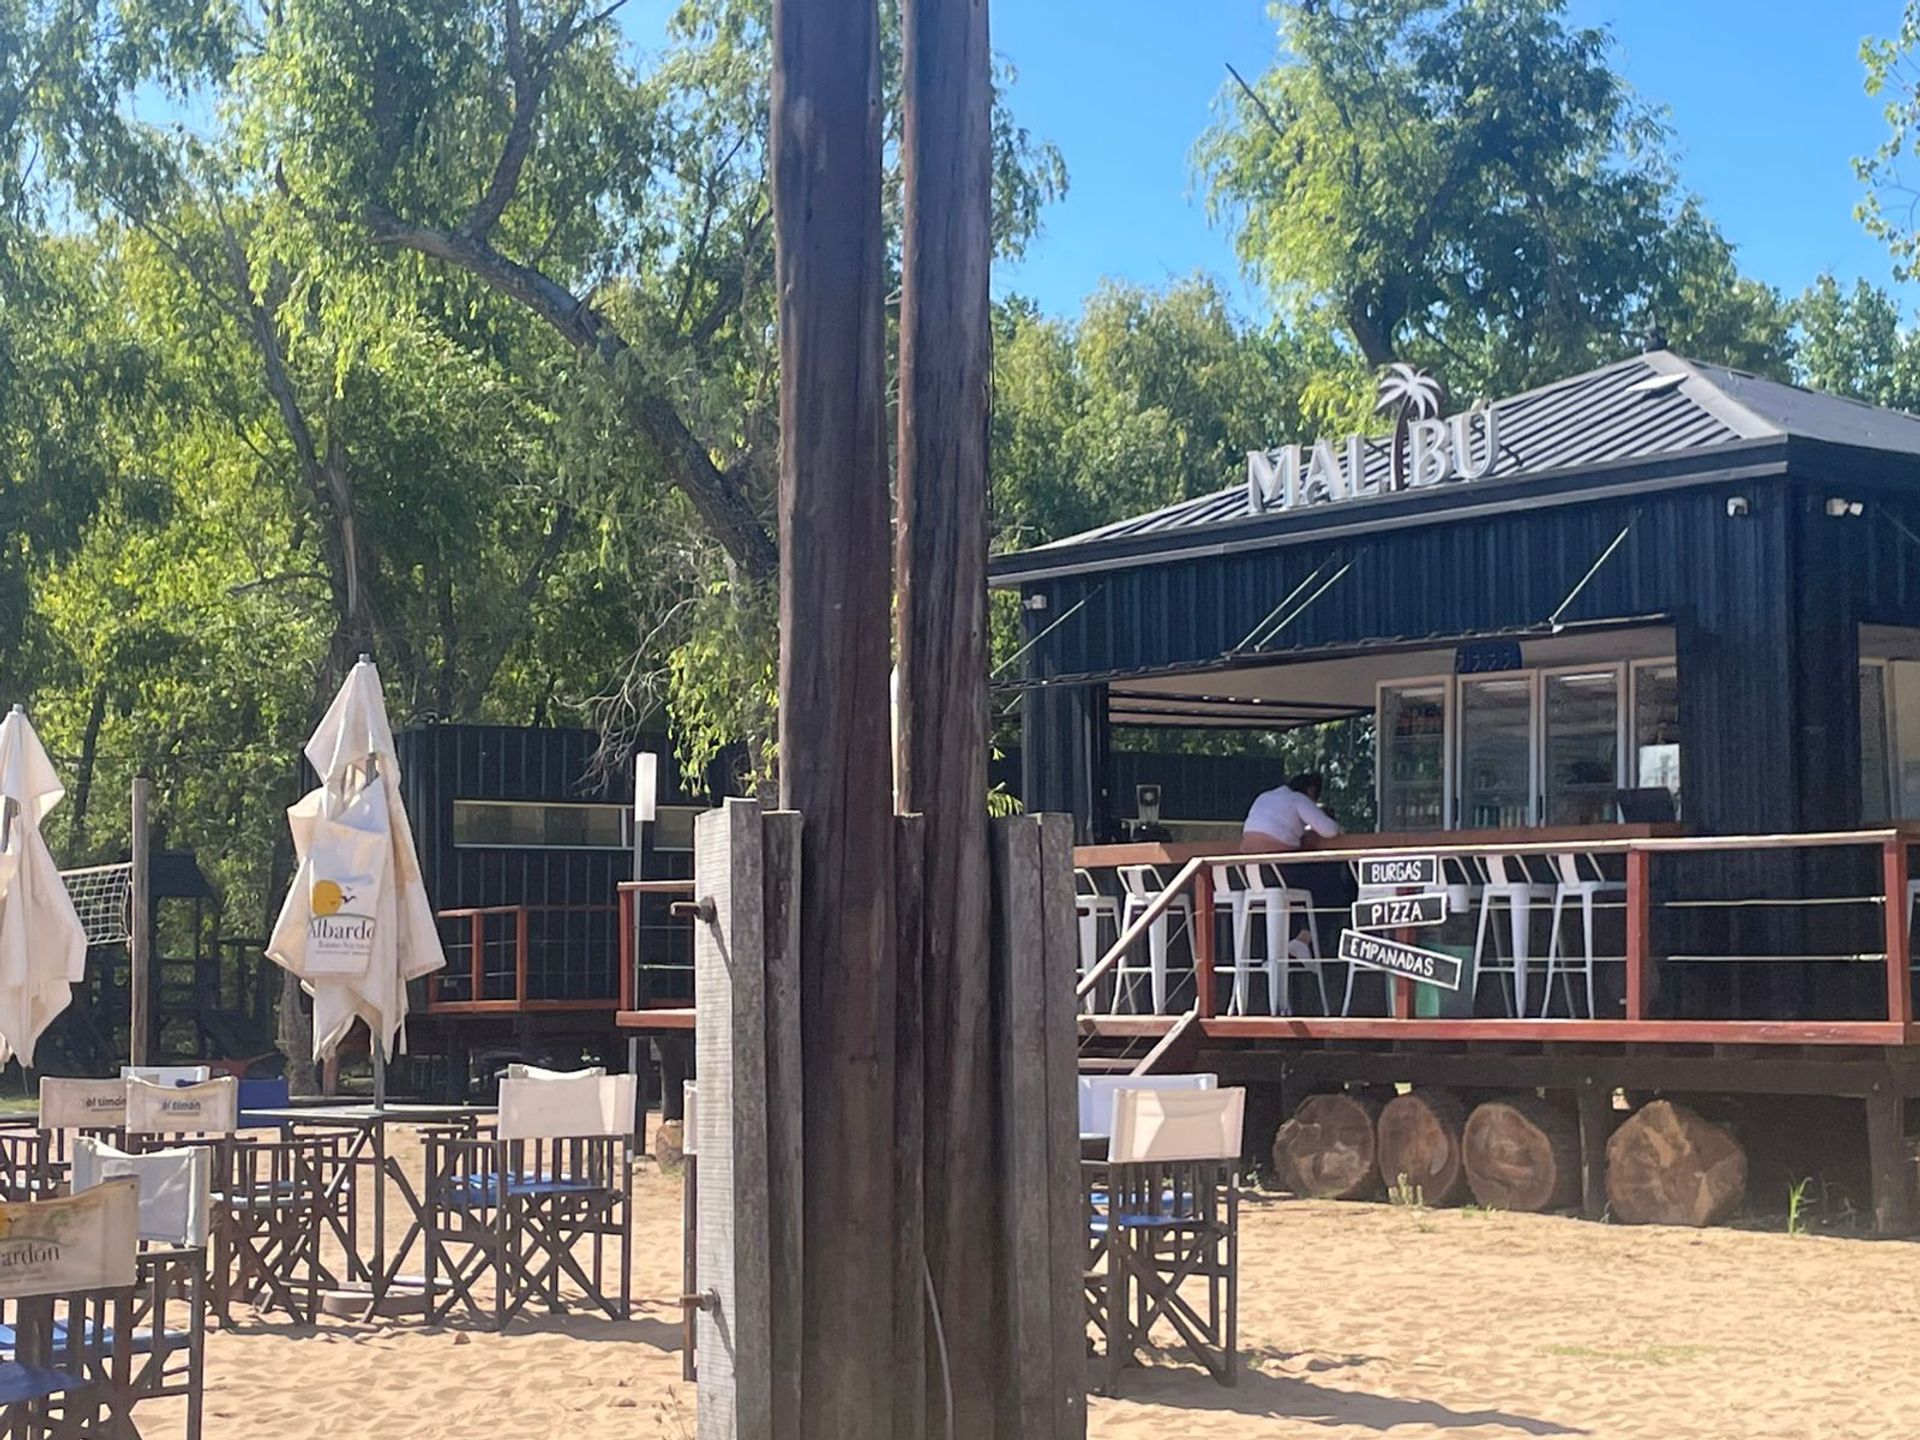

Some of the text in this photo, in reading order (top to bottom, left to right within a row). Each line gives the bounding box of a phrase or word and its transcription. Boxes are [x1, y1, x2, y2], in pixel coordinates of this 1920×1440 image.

[1246, 363, 1499, 514] MALIBU
[1371, 861, 1422, 882] BURGAS
[1371, 902, 1423, 925] PIZZA
[1350, 938, 1434, 977] EMPANADAS
